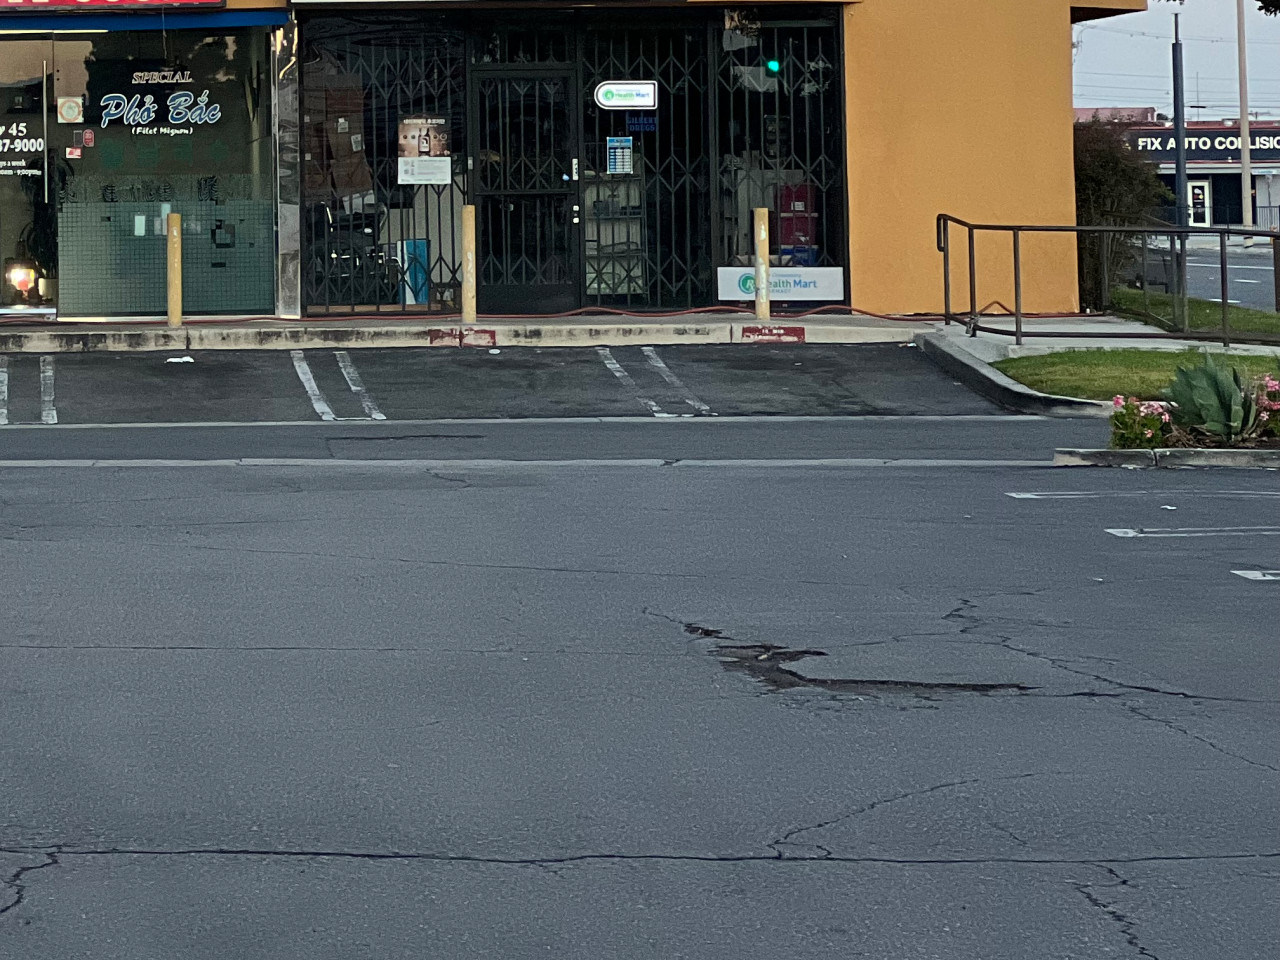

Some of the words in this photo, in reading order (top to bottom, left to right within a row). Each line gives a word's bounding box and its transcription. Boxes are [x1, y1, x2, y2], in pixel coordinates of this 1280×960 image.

[132, 71, 193, 84] SPECIAL
[8, 122, 27, 137] 45
[1138, 137, 1162, 150] FIX
[1166, 137, 1211, 150] ATO
[769, 279, 792, 288] ealth
[793, 279, 817, 288] Mart
